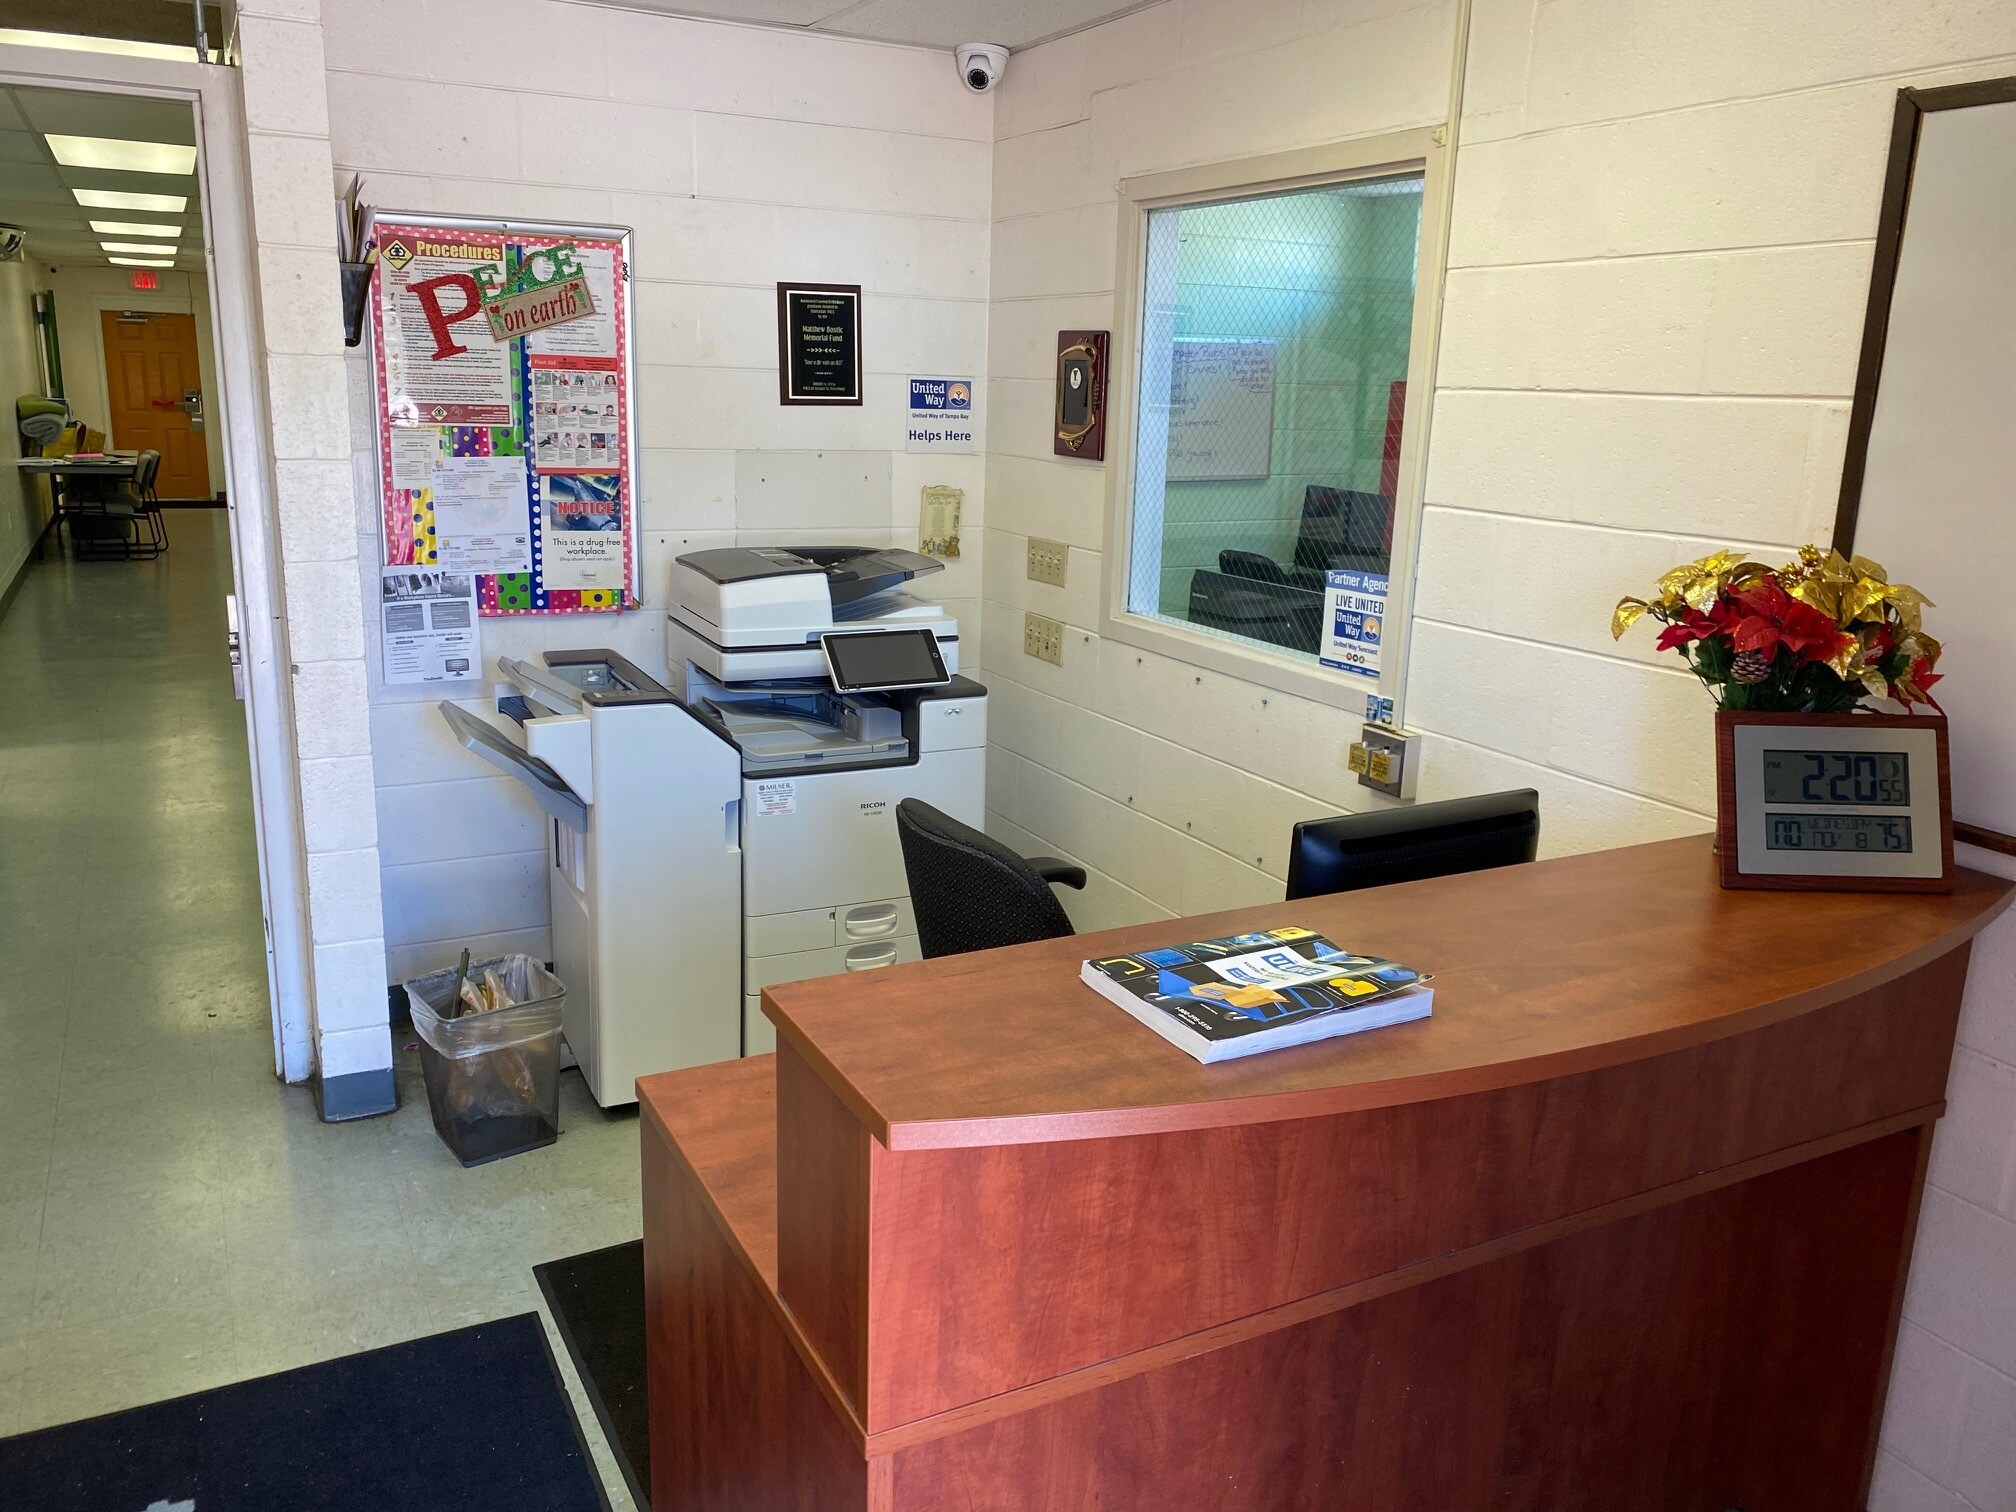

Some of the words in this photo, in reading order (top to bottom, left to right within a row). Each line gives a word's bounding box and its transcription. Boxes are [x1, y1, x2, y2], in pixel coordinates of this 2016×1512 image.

[416, 240, 500, 260] Procedures
[134, 271, 156, 288] EXIT
[503, 309, 527, 332] on
[530, 285, 577, 325] earth
[802, 325, 825, 333] Matthew
[826, 326, 843, 334] Bostic
[803, 333, 828, 341] Memorial
[829, 334, 843, 342] Fund
[912, 382, 945, 394] United
[924, 394, 945, 408] Way
[909, 429, 942, 443] Helps
[945, 430, 971, 441] Here
[557, 501, 615, 516] NOTICE
[552, 537, 568, 546] This
[570, 538, 577, 546] is
[586, 537, 621, 548] drug-free
[566, 547, 608, 557] workplace.
[1328, 571, 1360, 587] Partner
[1362, 576, 1389, 592] Agenc
[1335, 594, 1353, 609] LIVE
[1355, 597, 1384, 614] UNITED
[1336, 611, 1361, 626] United
[1345, 624, 1361, 639] Way
[1333, 640, 1348, 648] United
[1348, 642, 1357, 651] Way
[1358, 645, 1378, 655] Suncoast
[1767, 760, 1781, 769] PM
[1802, 754, 1878, 801] 2:20
[765, 782, 791, 791] MILNER
[860, 801, 886, 810] RICOH
[1855, 832, 1868, 849] 8
